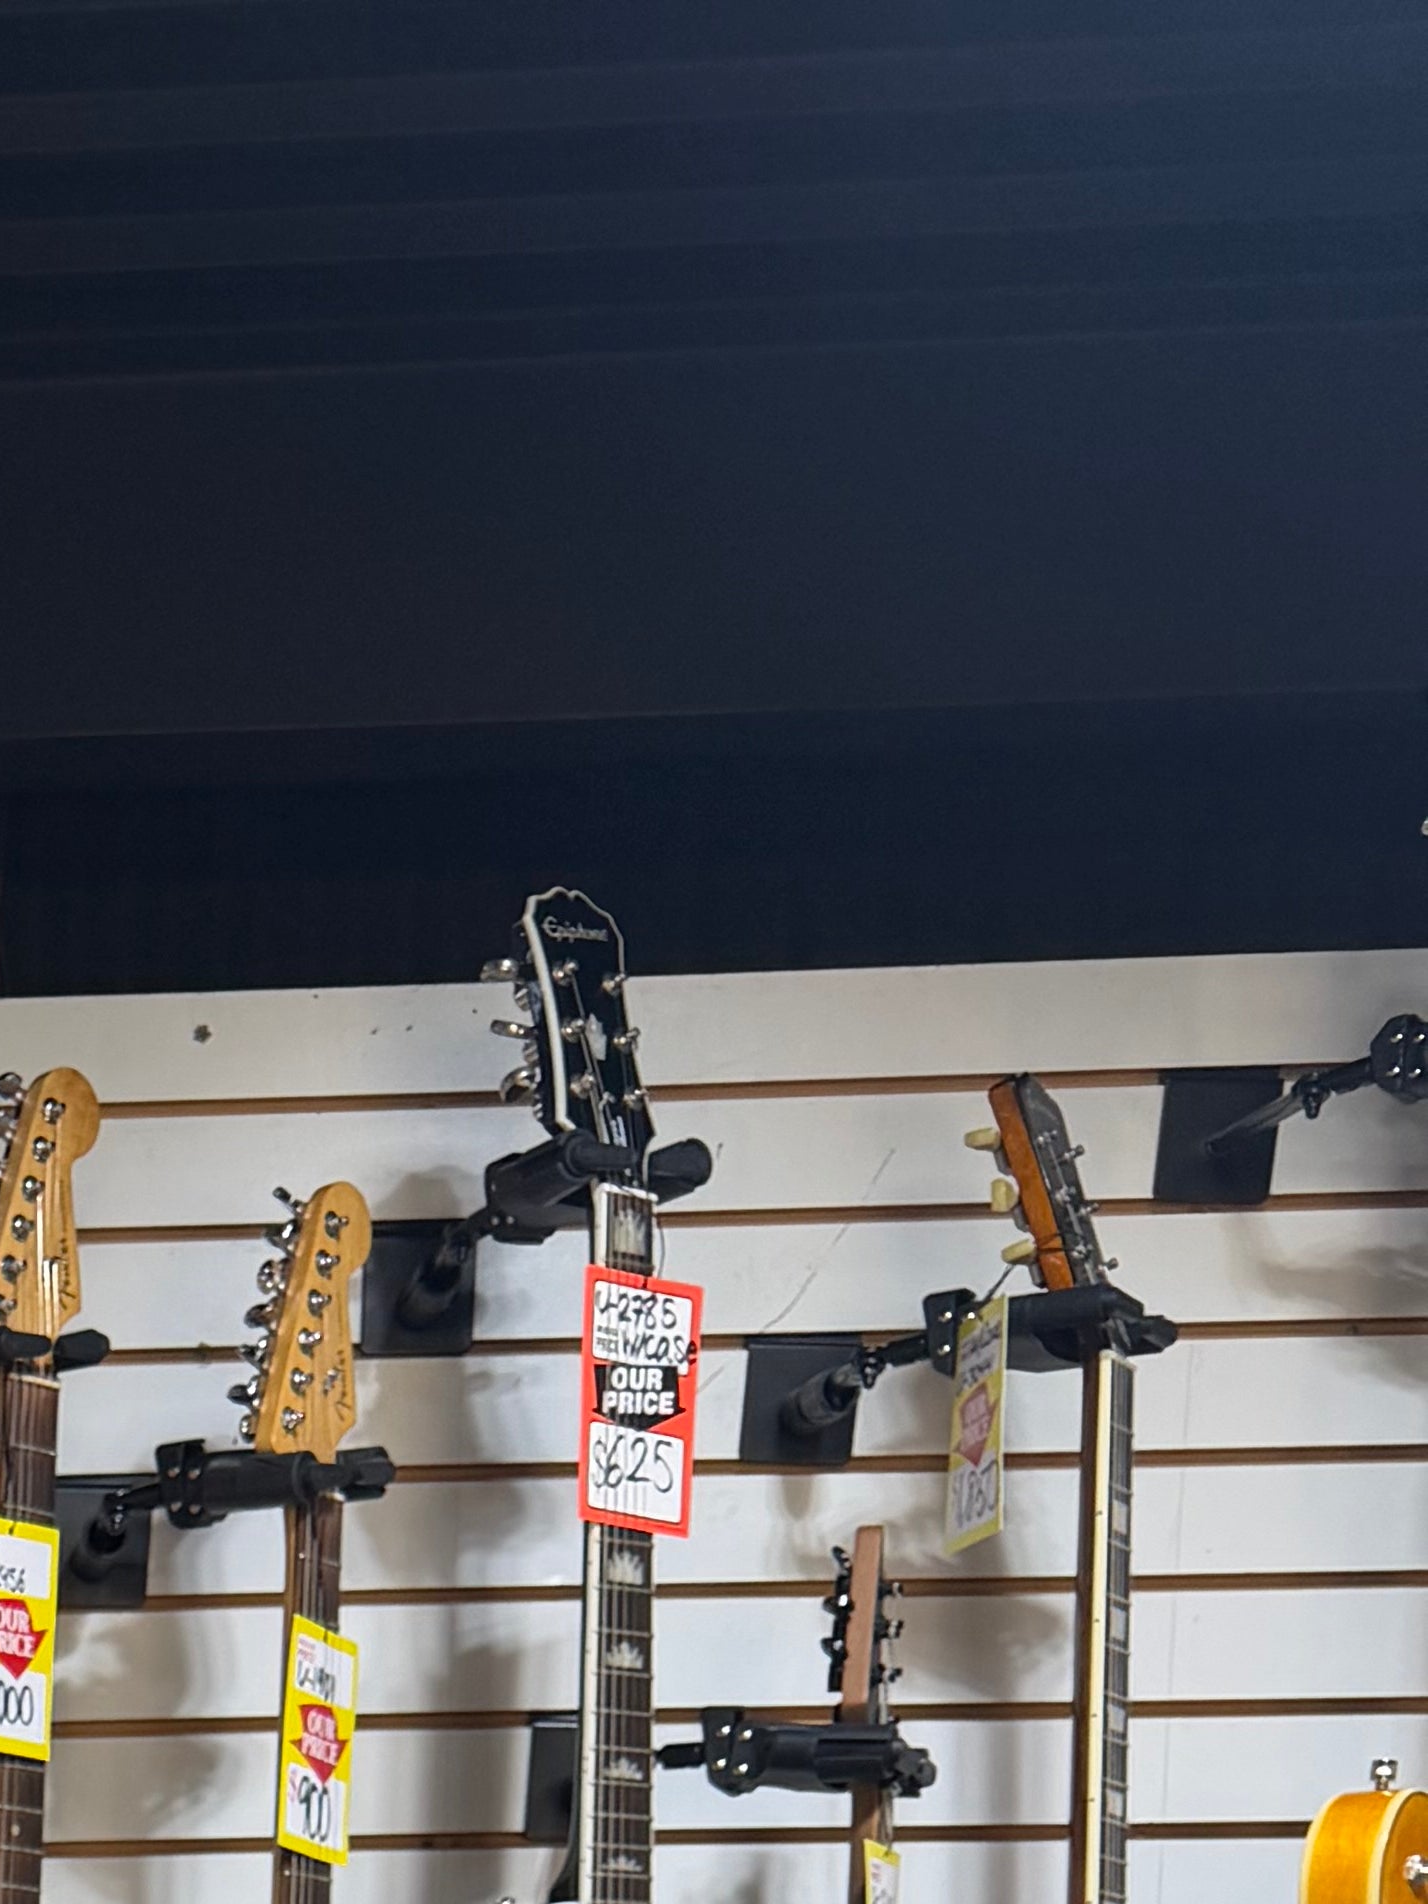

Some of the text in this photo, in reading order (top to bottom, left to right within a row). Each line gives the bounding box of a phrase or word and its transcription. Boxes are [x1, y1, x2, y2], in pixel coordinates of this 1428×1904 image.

[541, 915, 609, 943] Epiphone
[611, 1366, 663, 1391] OUR
[601, 1390, 676, 1416] PRICE
[592, 1433, 675, 1493] $625
